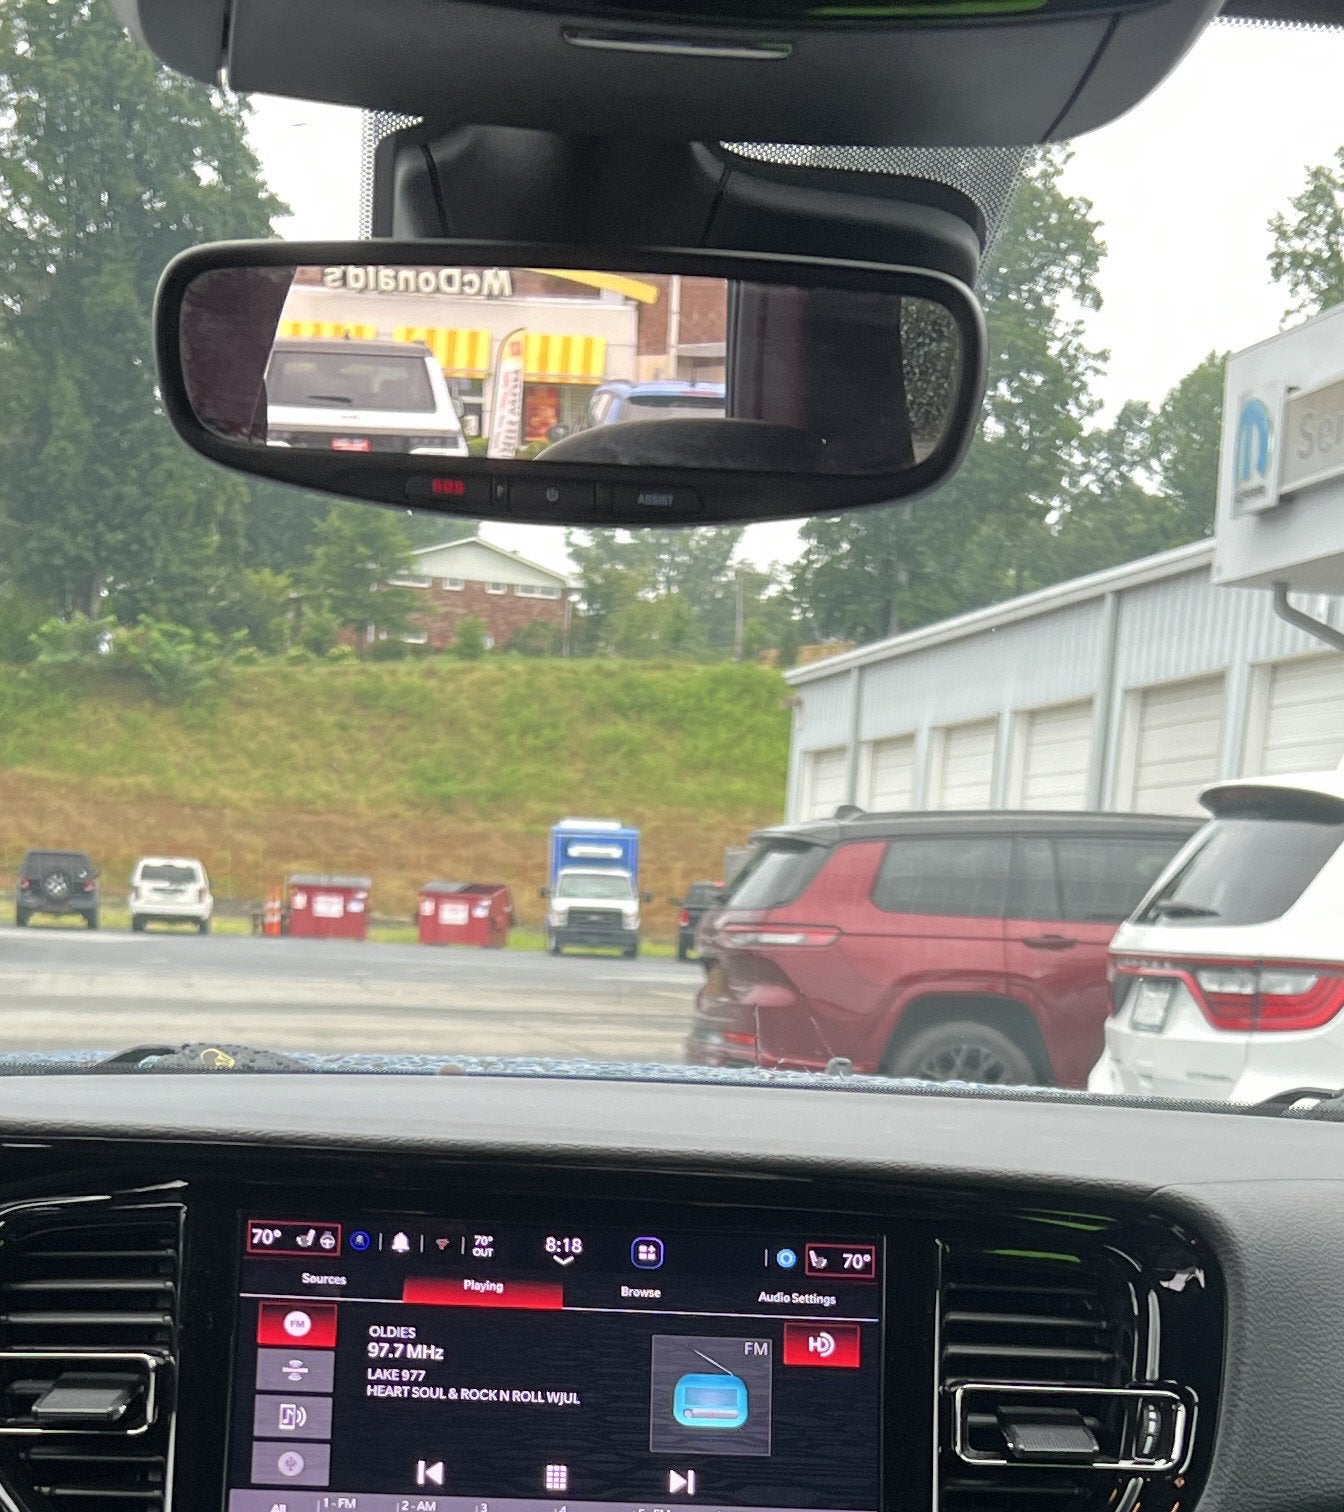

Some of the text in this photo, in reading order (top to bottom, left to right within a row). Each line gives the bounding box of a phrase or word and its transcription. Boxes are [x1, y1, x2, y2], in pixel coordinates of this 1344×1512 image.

[251, 1228, 282, 1245] 70°
[545, 1236, 583, 1253] 8:18
[472, 1247, 494, 1258] OUT
[842, 1252, 872, 1270] 70°
[302, 1272, 347, 1286] Sources
[463, 1278, 504, 1294] Playing
[620, 1285, 662, 1299] Browse
[758, 1291, 837, 1307] Audio Settings
[290, 1319, 305, 1330] FM
[368, 1325, 416, 1339] OLDIES
[367, 1342, 444, 1361] 97.7 MHz
[744, 1341, 768, 1356] FM
[367, 1368, 426, 1383] LAKE 977
[366, 1384, 411, 1398] HEART
[412, 1386, 447, 1399] SOUL
[447, 1388, 458, 1400] &
[460, 1388, 498, 1401] ROCK
[499, 1390, 510, 1402] N
[511, 1390, 545, 1403] ROLL
